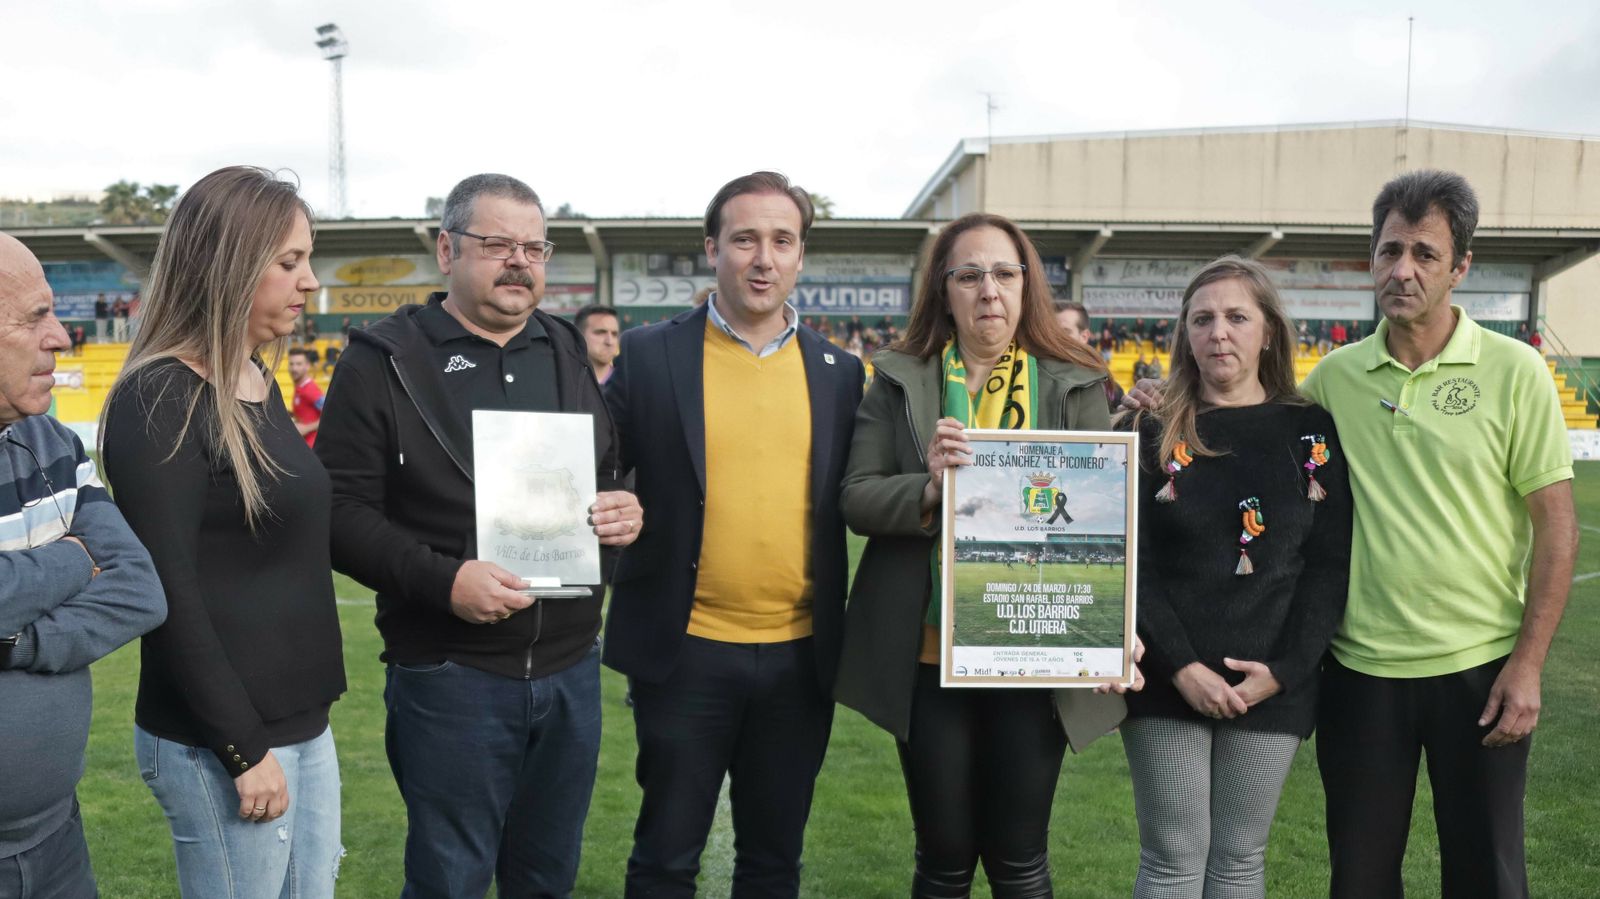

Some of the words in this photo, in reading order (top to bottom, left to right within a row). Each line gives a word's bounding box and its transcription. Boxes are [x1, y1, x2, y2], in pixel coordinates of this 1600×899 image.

[1432, 384, 1443, 397] BAR
[1443, 377, 1480, 398] RESTAURANTE
[1019, 445, 1057, 455] HOMENAJE
[1058, 446, 1064, 455] A
[973, 450, 996, 467] JOSÉ
[998, 451, 1041, 468] SÁNCHEZ
[1059, 457, 1109, 470] PICONERO"
[494, 544, 518, 560] Villa
[520, 547, 531, 560] de
[533, 549, 550, 562] Los
[986, 582, 1017, 593] DOMINGO
[1018, 584, 1022, 593] /
[1023, 583, 1032, 593] 24
[1033, 584, 1041, 593] DE
[1042, 584, 1066, 593] MARZO
[1067, 584, 1071, 593] /
[1073, 584, 1091, 594] 17:30
[983, 593, 1009, 603] ESTADIO
[1010, 594, 1025, 603] SAN
[1052, 595, 1064, 604] LOS
[1065, 595, 1094, 605] BARRIOS
[996, 604, 1016, 618] U.D.
[1017, 604, 1036, 618] LOS
[1037, 605, 1080, 619] BARRIOS
[1009, 619, 1028, 634] C.D.
[1029, 620, 1067, 635] UTRERA
